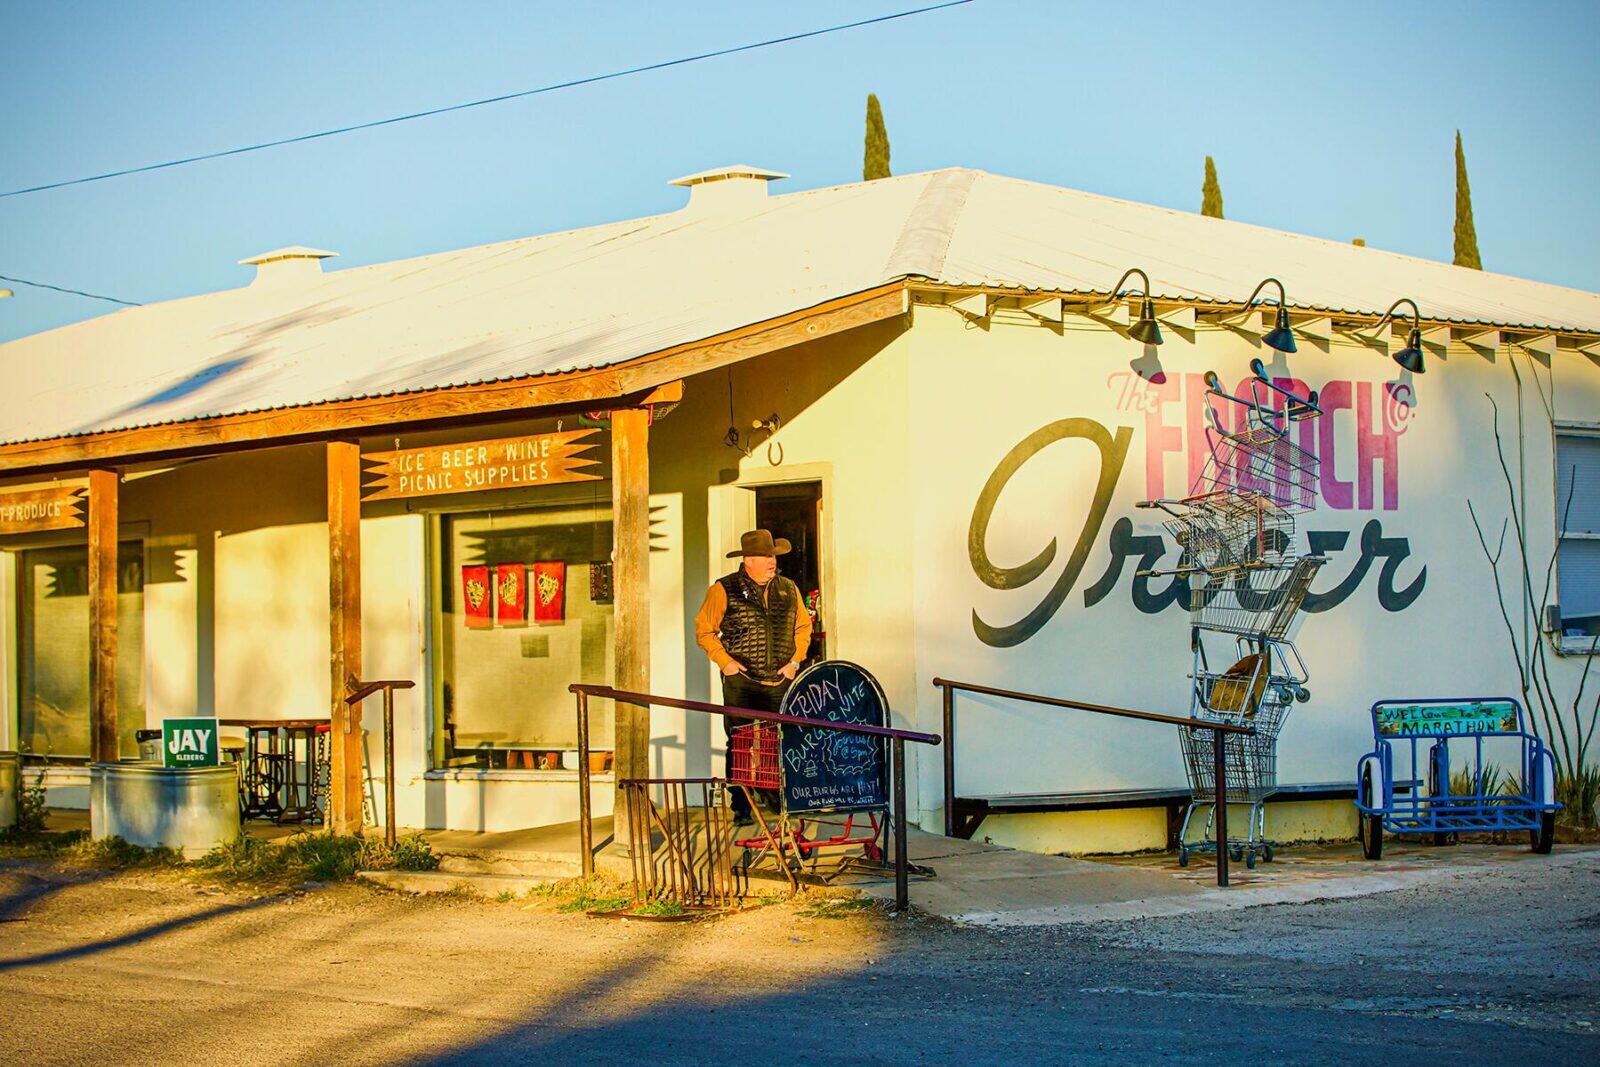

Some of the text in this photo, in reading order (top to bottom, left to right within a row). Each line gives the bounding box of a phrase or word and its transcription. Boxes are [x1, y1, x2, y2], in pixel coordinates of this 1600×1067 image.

[1106, 371, 1160, 415] The
[399, 439, 552, 474] ICE BEER WINE
[400, 462, 549, 493] PICNIC SUPPLIES
[789, 668, 846, 720] FRIDAY
[840, 681, 865, 718] NITE
[168, 729, 212, 755] JAY
[1402, 720, 1496, 735] MARATHON
[791, 786, 813, 800] OUR
